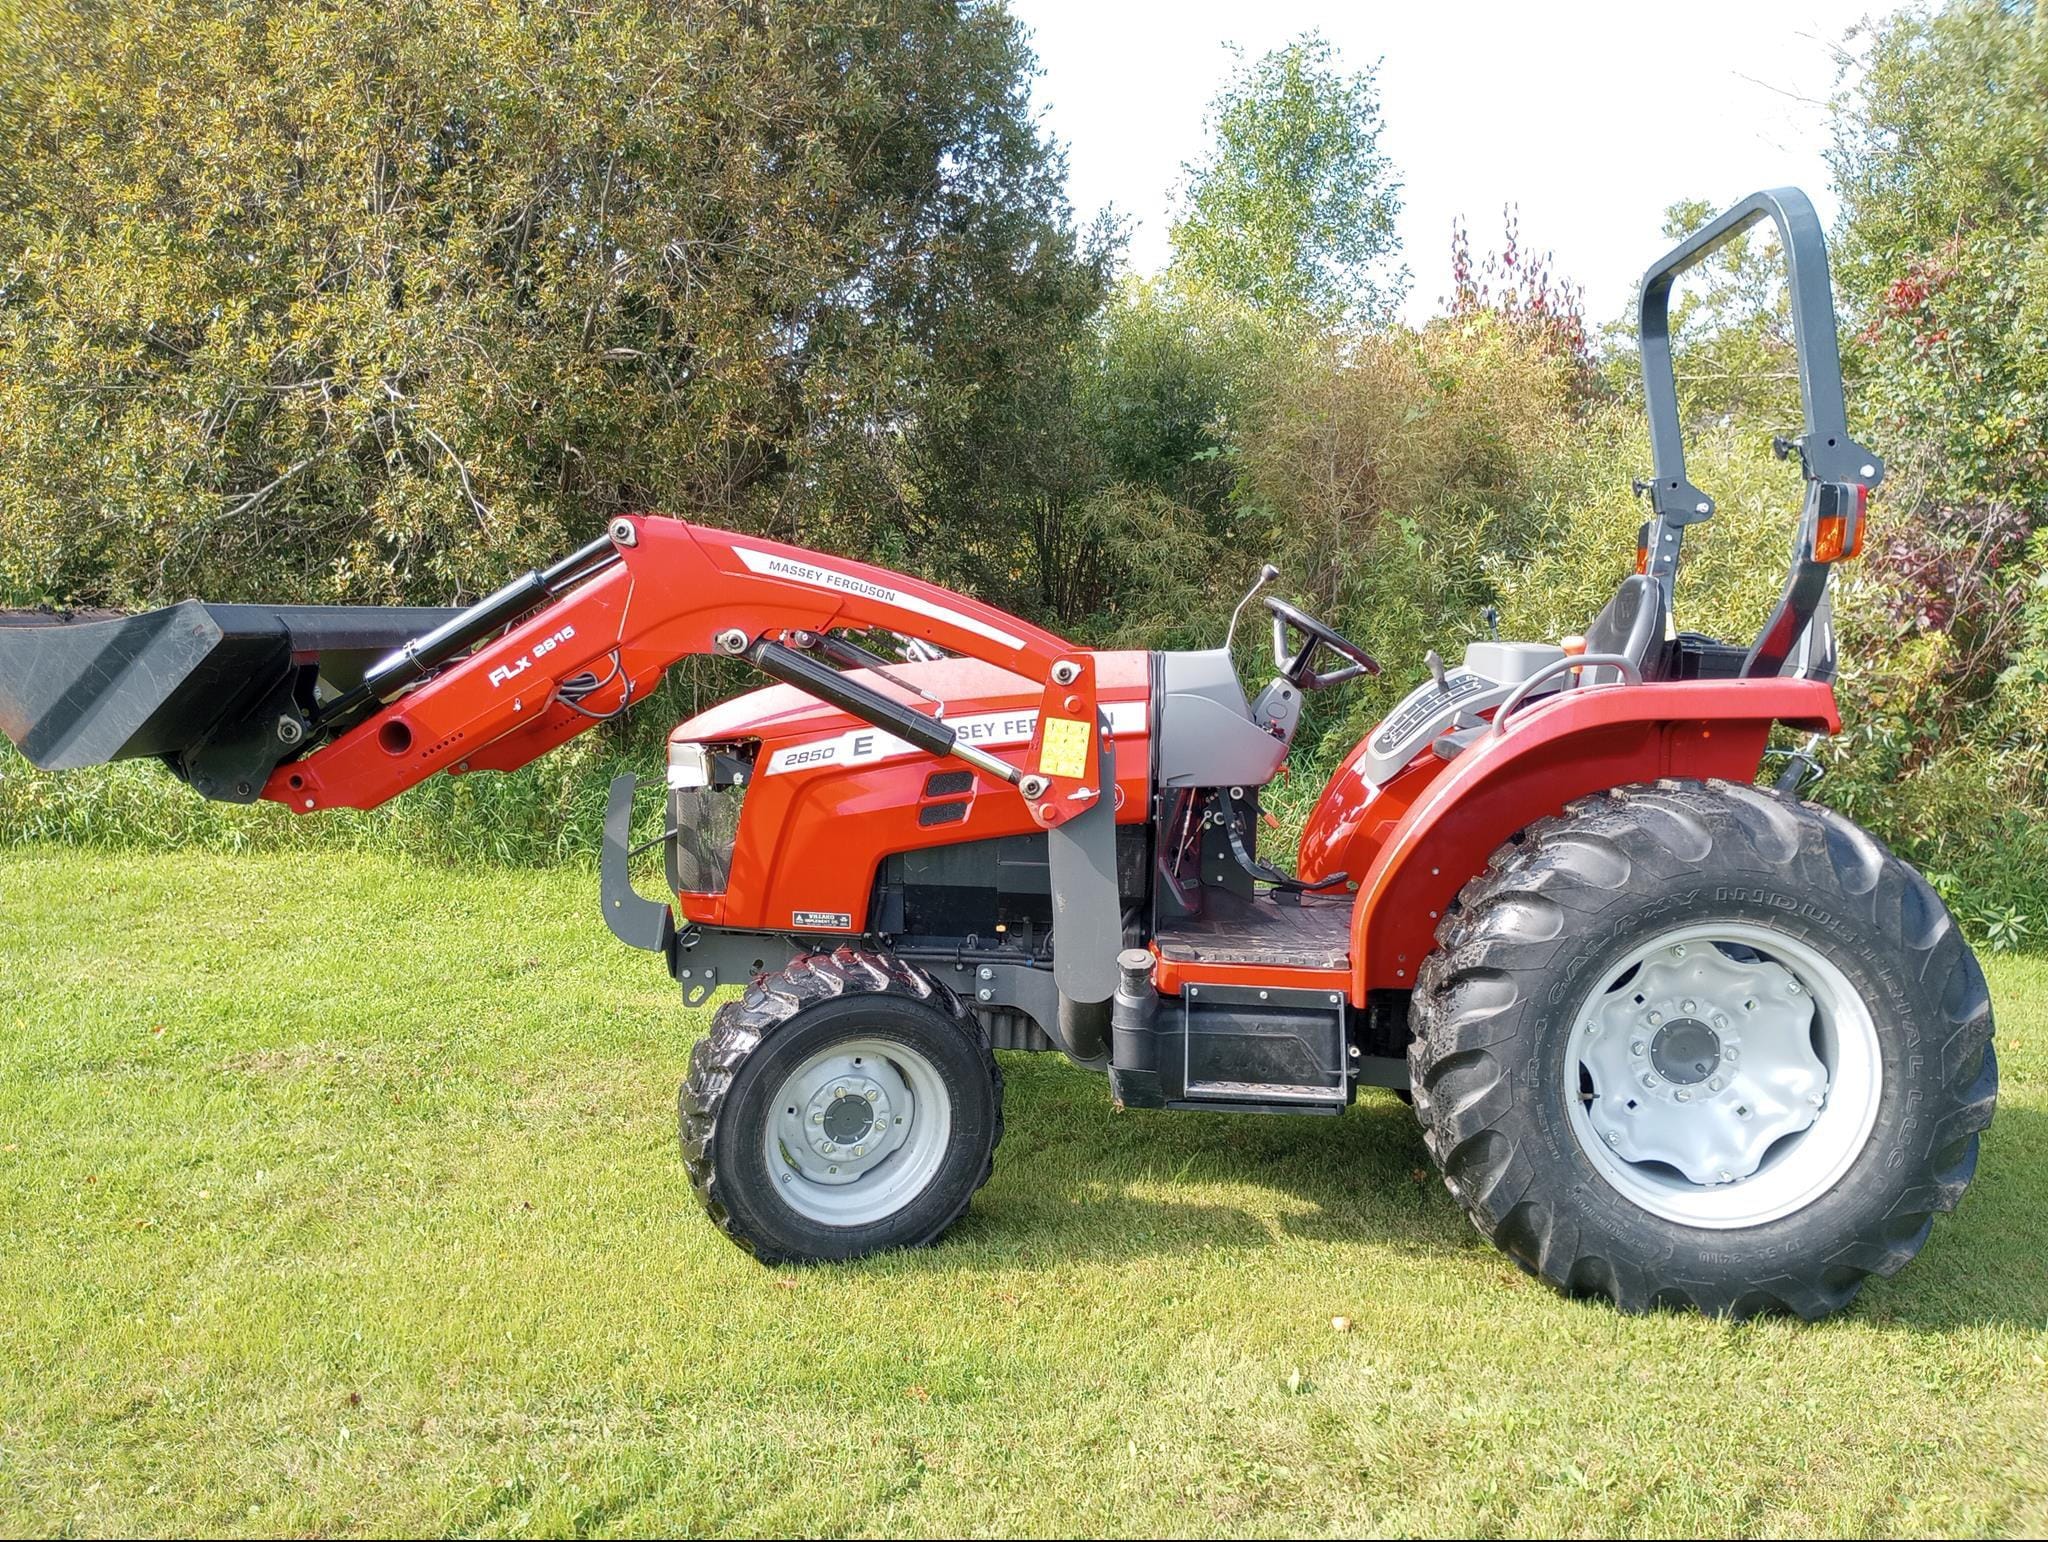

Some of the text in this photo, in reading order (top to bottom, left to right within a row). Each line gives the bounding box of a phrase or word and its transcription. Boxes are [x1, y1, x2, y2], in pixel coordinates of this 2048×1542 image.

[768, 560, 896, 602] MASSEY FERGUSON
[784, 735, 874, 766] 2850 E
